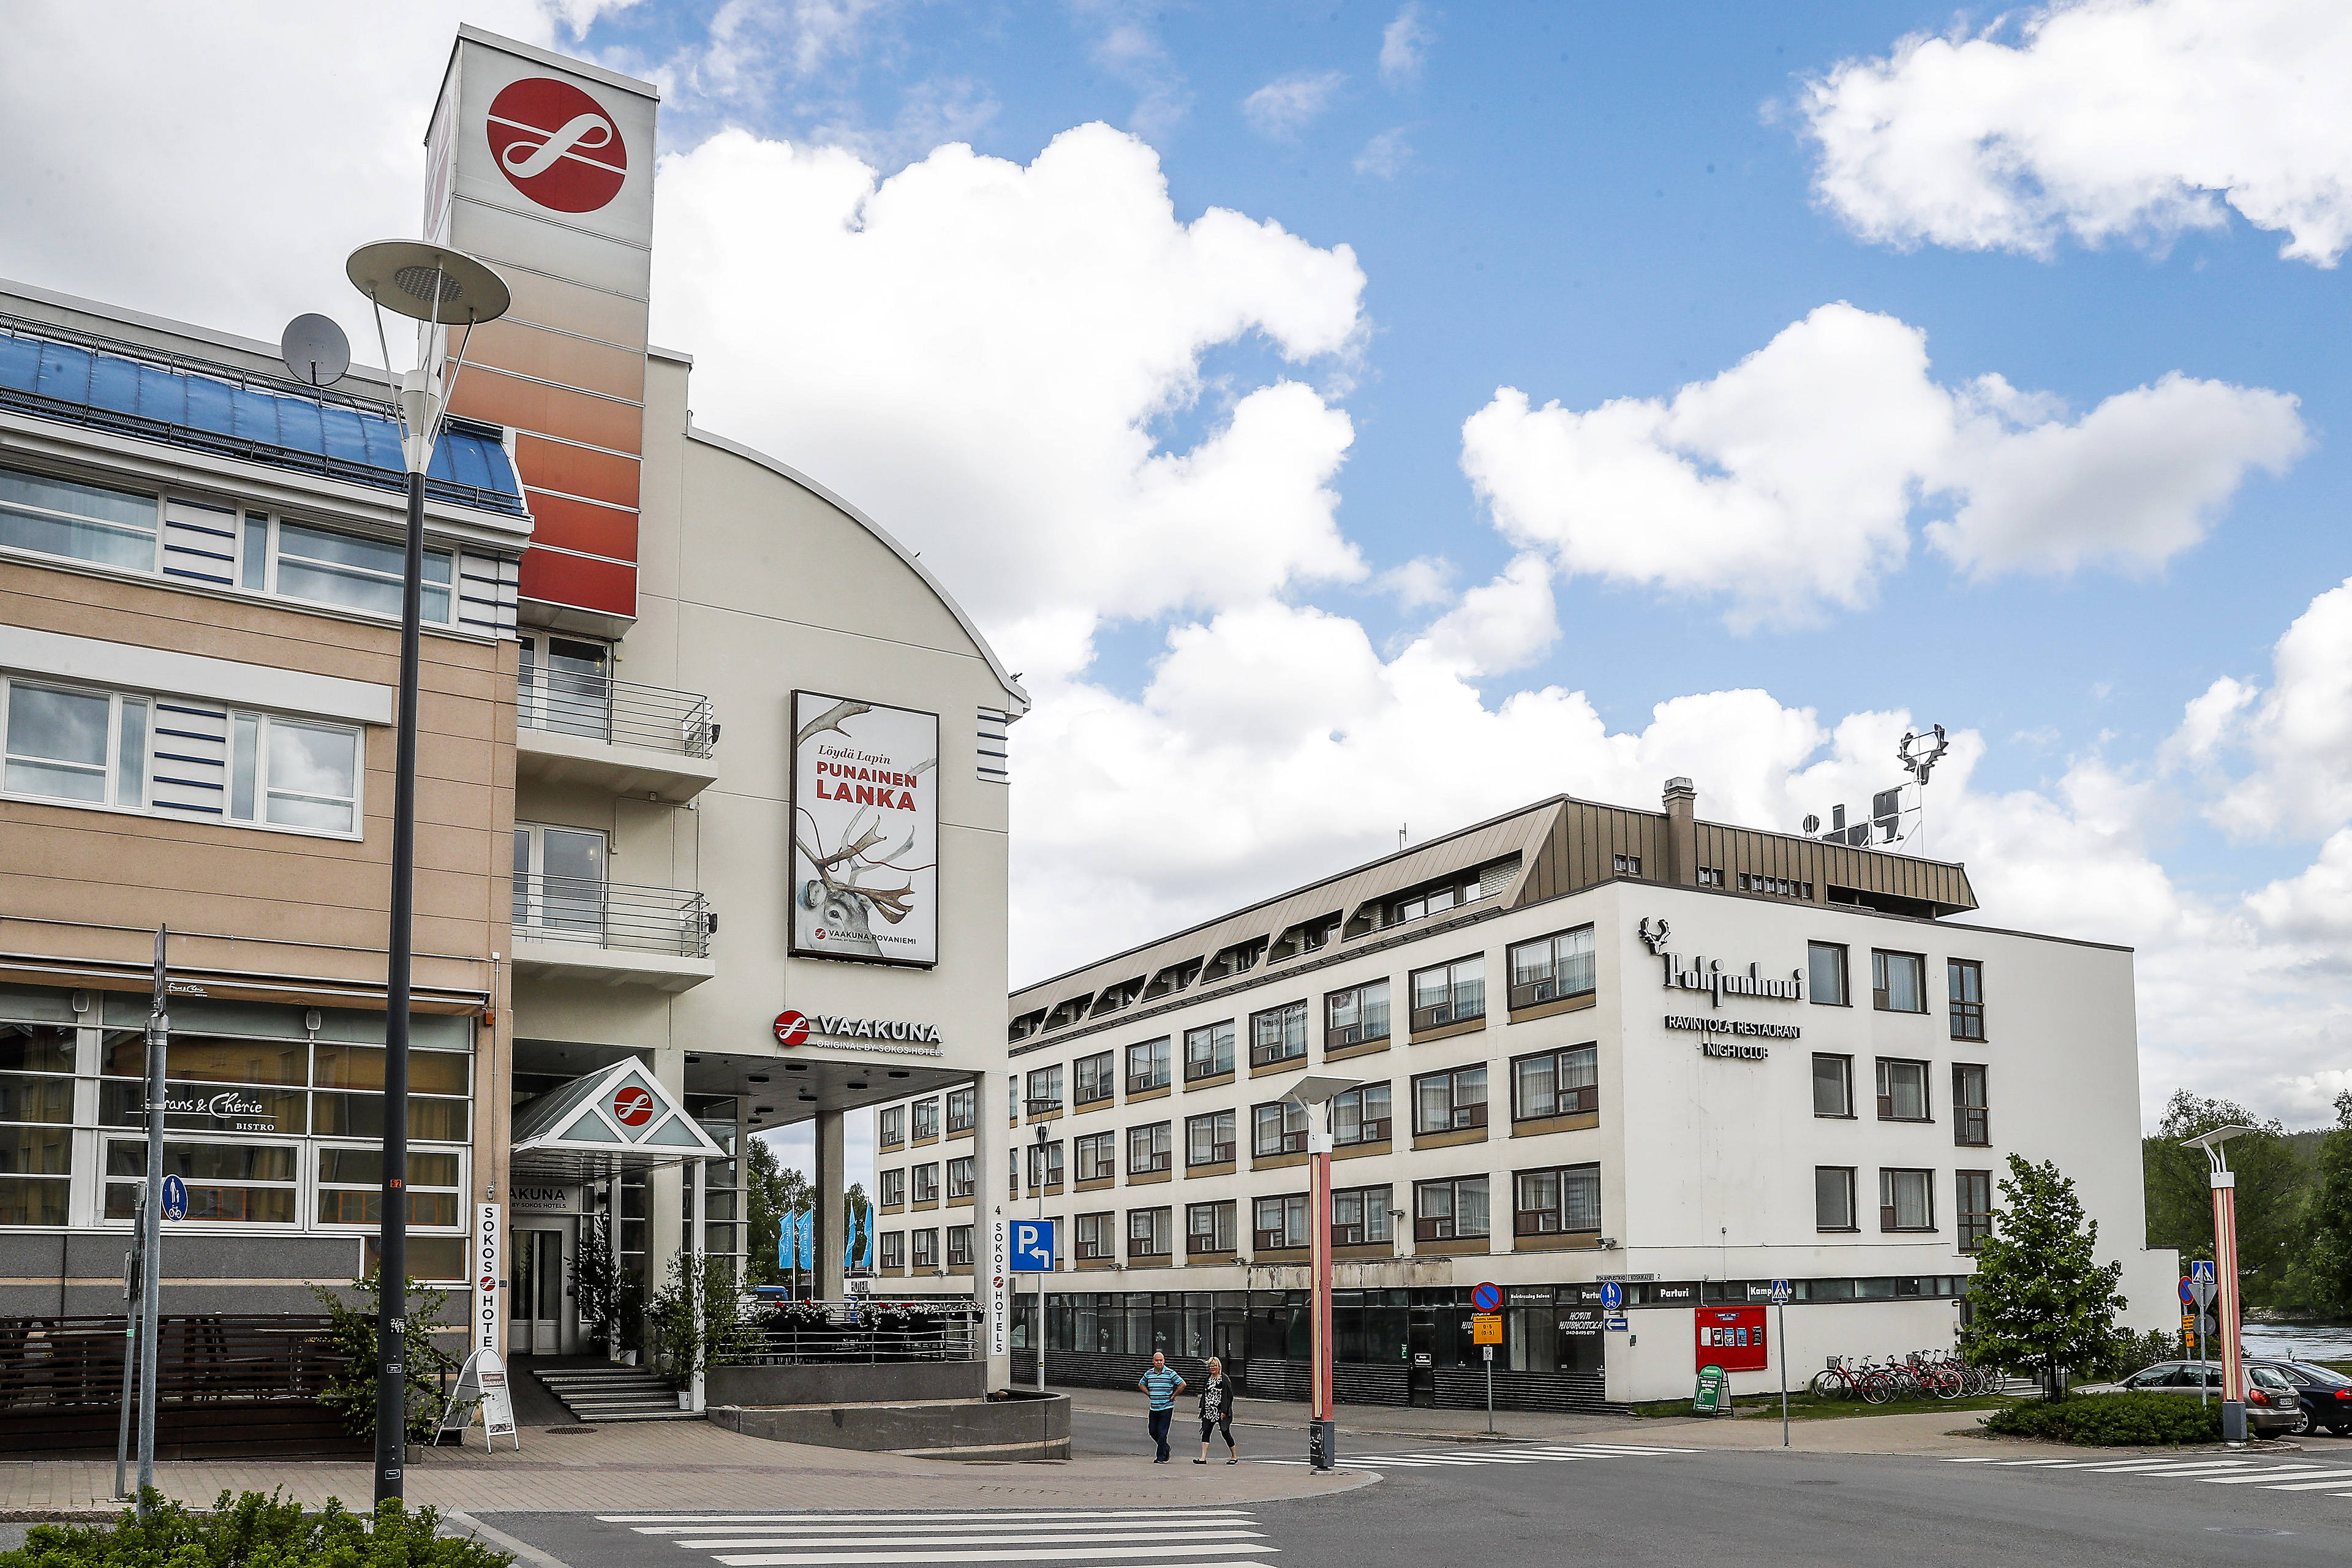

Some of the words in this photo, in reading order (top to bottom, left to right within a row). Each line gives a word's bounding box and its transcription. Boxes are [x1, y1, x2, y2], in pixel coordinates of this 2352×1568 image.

[818, 744, 854, 760] Löydä
[856, 750, 891, 765] Lapin
[816, 761, 917, 788] PUNAINEN
[816, 779, 917, 812] LANKA
[829, 930, 869, 940] VAAKUNA
[872, 934, 916, 945] ROVANIEMI
[818, 1014, 944, 1043] VAAKUNA
[1665, 1015, 1731, 1033] RAVINTOLA
[1733, 1021, 1802, 1039] RESTAURANT
[816, 1040, 862, 1050] ORIGINAL
[864, 1043, 876, 1052] BY
[878, 1044, 910, 1055] SOKOS
[911, 1047, 946, 1057] HOTELS
[1703, 1042, 1770, 1060] NIGHTCLUB
[195, 1099, 208, 1112] &
[209, 1092, 263, 1118] Chérie
[236, 1123, 275, 1131] BISTRO
[510, 1187, 566, 1200] AKUNA
[995, 1205, 1001, 1215] 4
[482, 1207, 495, 1273] SOKOS
[994, 1222, 1003, 1273] SOKOS
[1018, 1225, 1039, 1254] P
[1660, 1287, 1689, 1298] Parturi
[1751, 1287, 1792, 1296] Kampo
[481, 1295, 494, 1348] HOTE
[995, 1291, 1003, 1353] HOTELS
